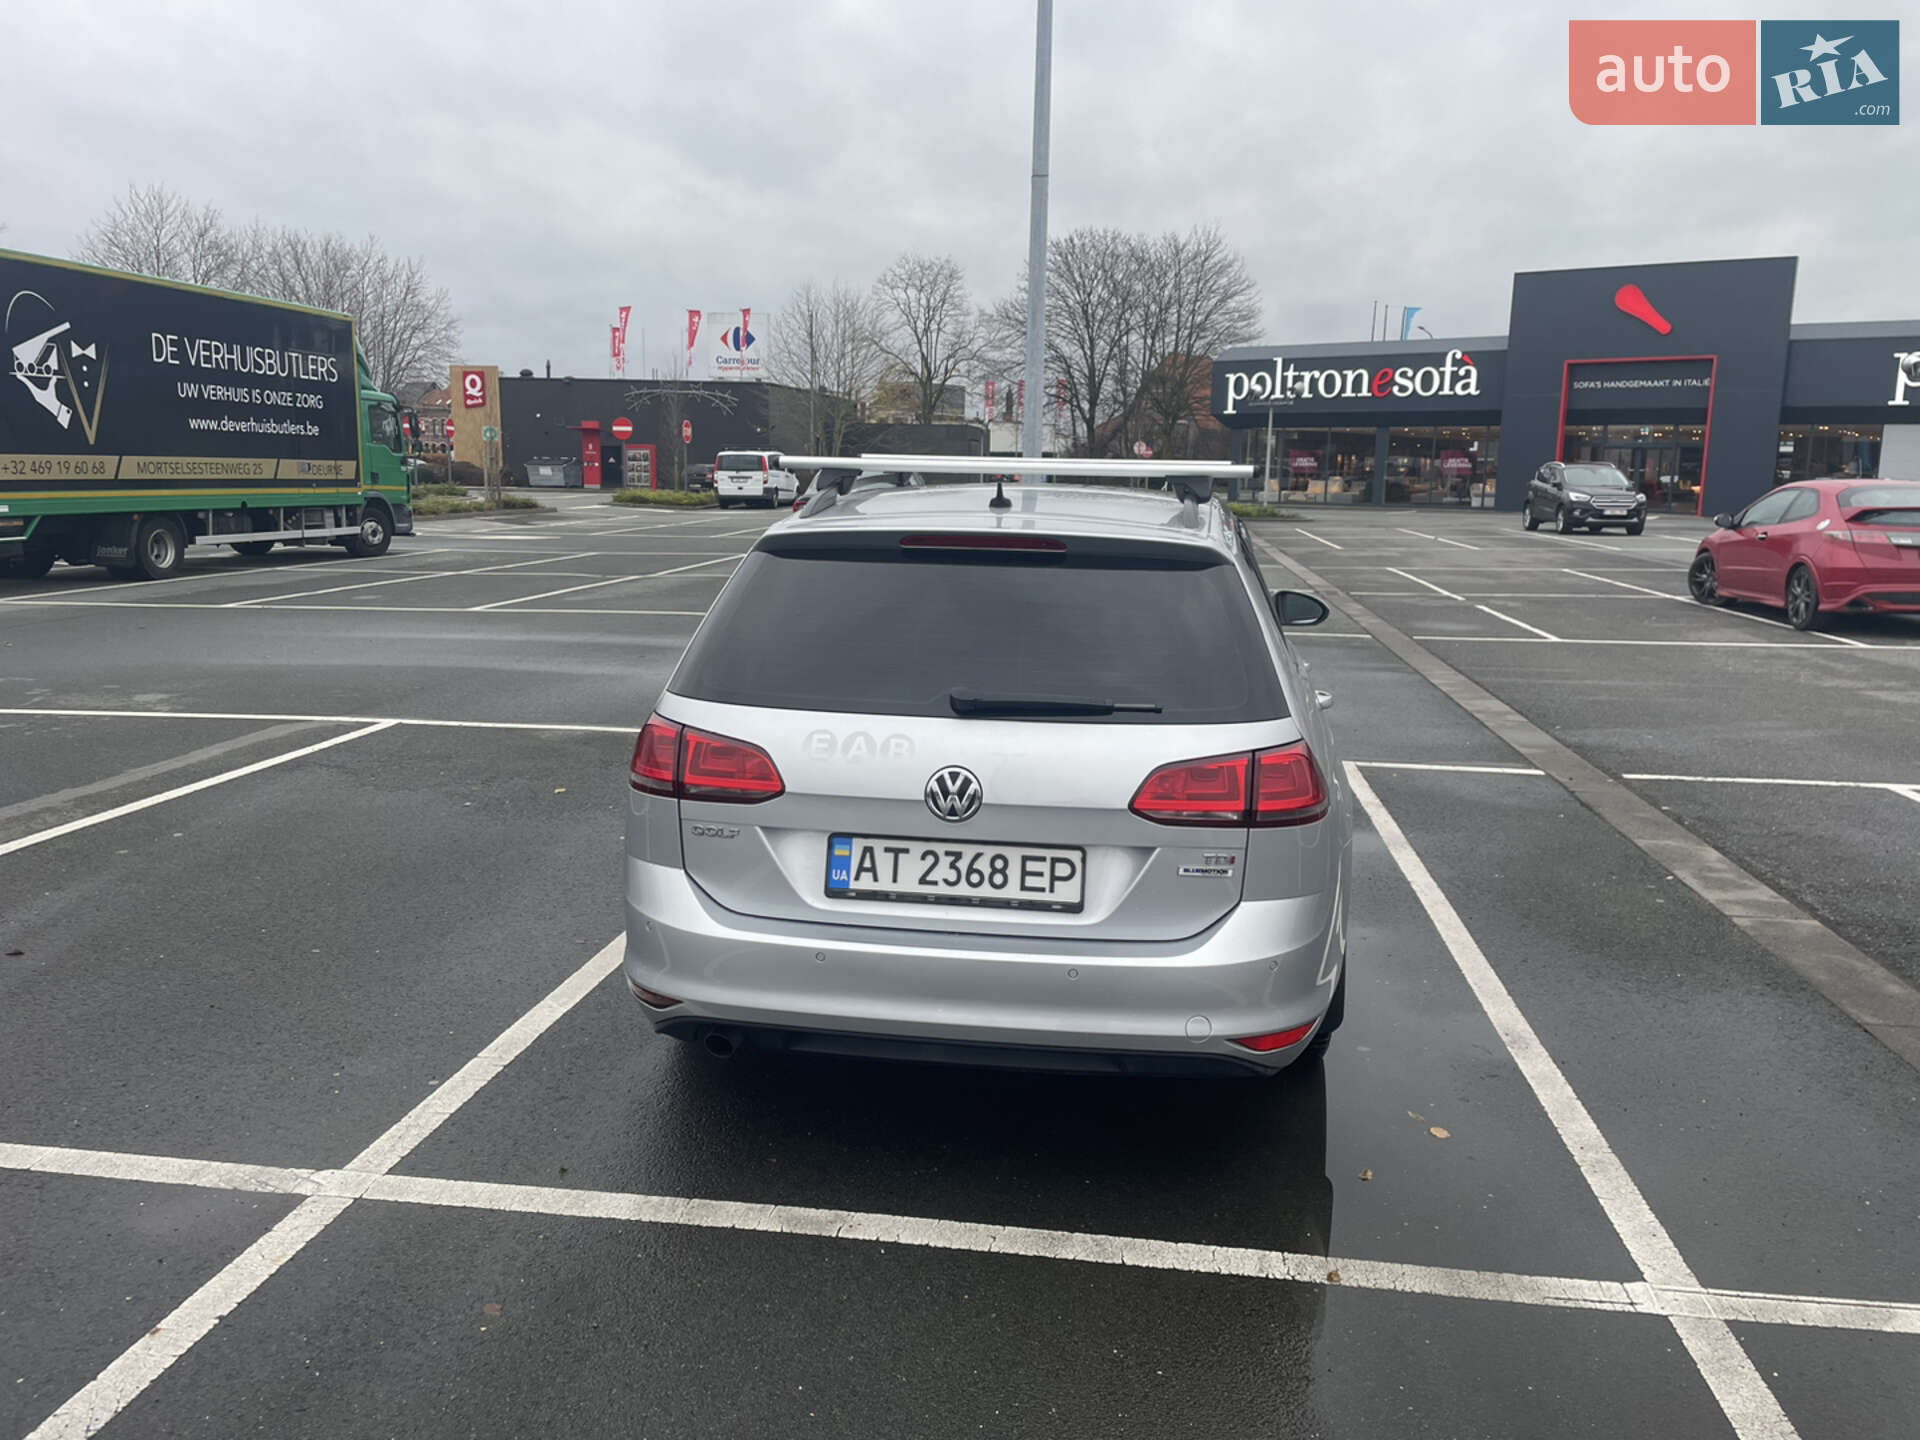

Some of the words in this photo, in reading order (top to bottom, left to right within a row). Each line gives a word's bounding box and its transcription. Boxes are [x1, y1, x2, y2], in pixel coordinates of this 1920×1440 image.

[151, 332, 180, 365] DE
[184, 336, 339, 383] VERHUISBUTLERS
[1223, 349, 1480, 415] poltronesofà
[177, 381, 199, 398] UW
[202, 384, 249, 403] VERHUIS
[252, 388, 262, 404] IS
[263, 390, 294, 407] ONZE
[295, 393, 324, 410] ZORG
[189, 415, 320, 436] www.deverhuisbutlers.be
[1, 460, 26, 475] +32
[30, 460, 52, 475] 469
[57, 460, 71, 475] 19
[74, 460, 89, 475] 60
[136, 461, 250, 475] MORTSELSESTEENWEG
[252, 462, 263, 475] 25
[832, 869, 849, 882] UA
[853, 845, 910, 884] AT
[917, 849, 1010, 891] 2368
[1019, 854, 1077, 894] EP
